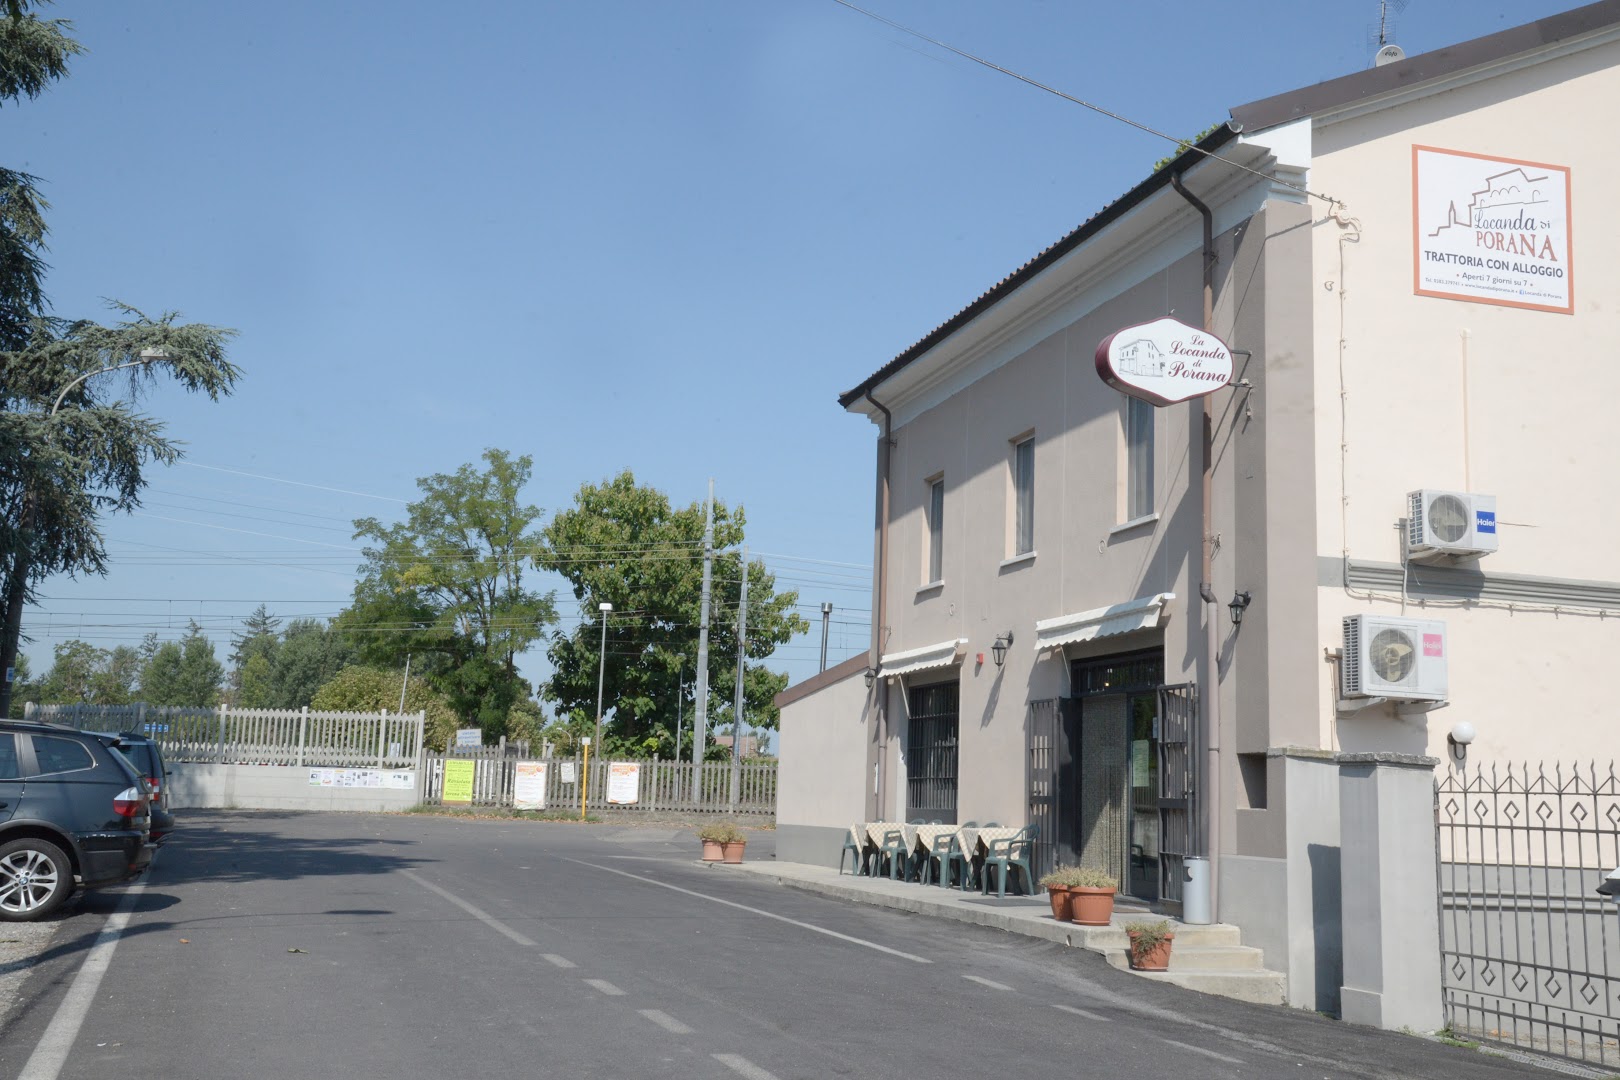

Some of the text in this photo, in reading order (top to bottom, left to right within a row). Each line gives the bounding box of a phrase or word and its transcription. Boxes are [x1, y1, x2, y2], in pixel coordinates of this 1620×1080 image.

[1474, 208, 1537, 231] Locanda
[1476, 230, 1558, 262] PORANA
[1424, 250, 1564, 278] TRATTORIA CON ALLOGGIO
[1461, 272, 1485, 283] Aperti
[1492, 276, 1513, 285] giorni
[1168, 340, 1226, 360] Locanda
[1190, 335, 1204, 346] La
[1168, 360, 1227, 383] Porana
[1192, 359, 1203, 367] di
[1477, 518, 1495, 527] Haier
